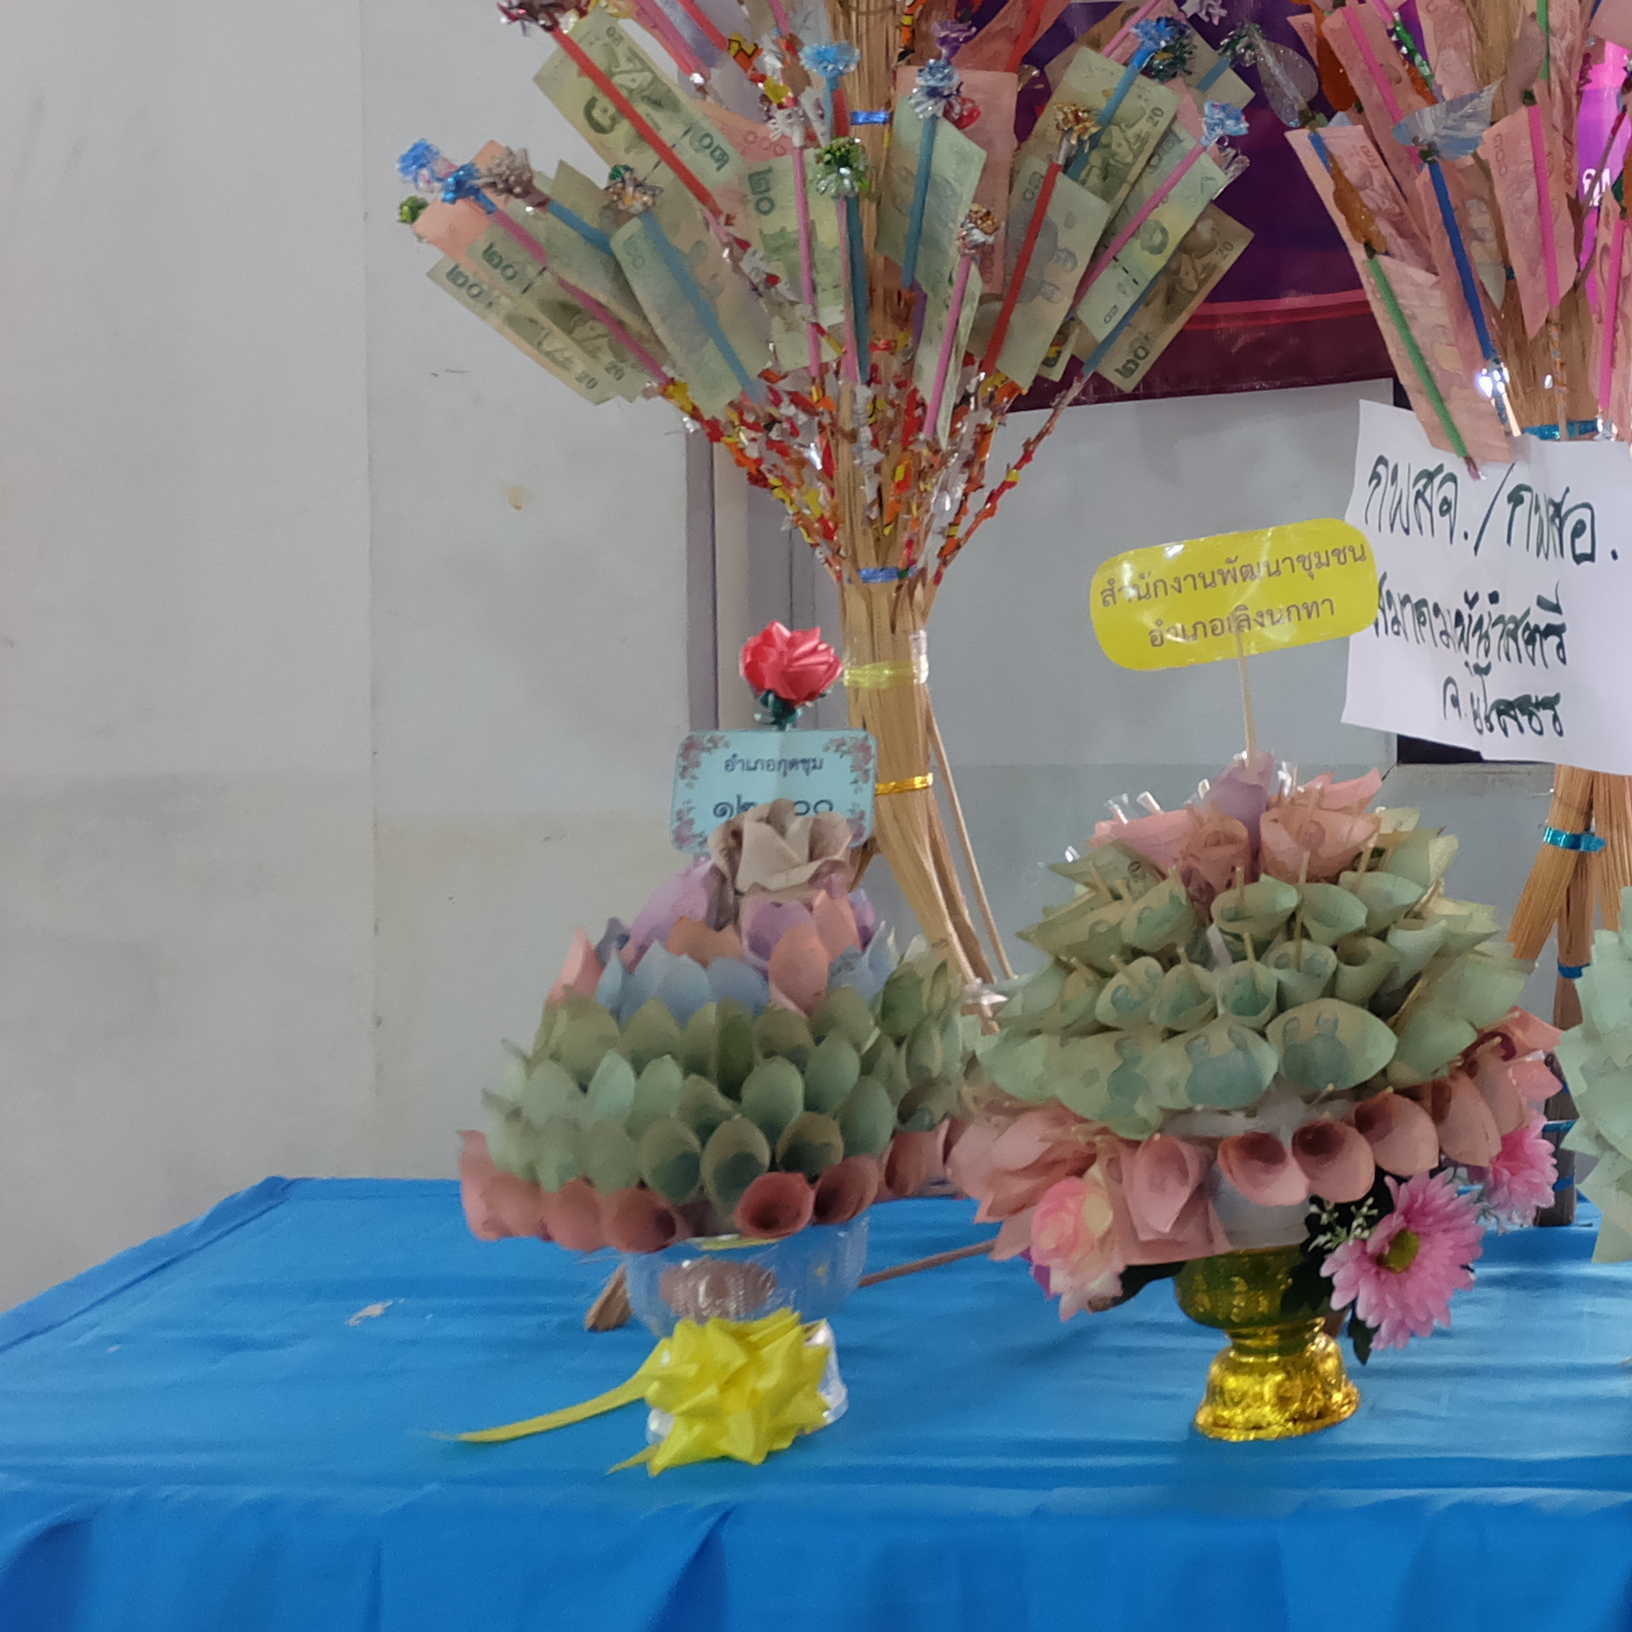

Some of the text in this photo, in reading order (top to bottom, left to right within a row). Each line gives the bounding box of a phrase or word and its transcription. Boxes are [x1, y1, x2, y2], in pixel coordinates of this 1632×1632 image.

[1100, 541, 1367, 609] สำนักงานพัฒนาชุมชน
[1149, 597, 1335, 649] อำเภอเลิงนกทา
[723, 752, 824, 779] อำเภอกุดชุม
